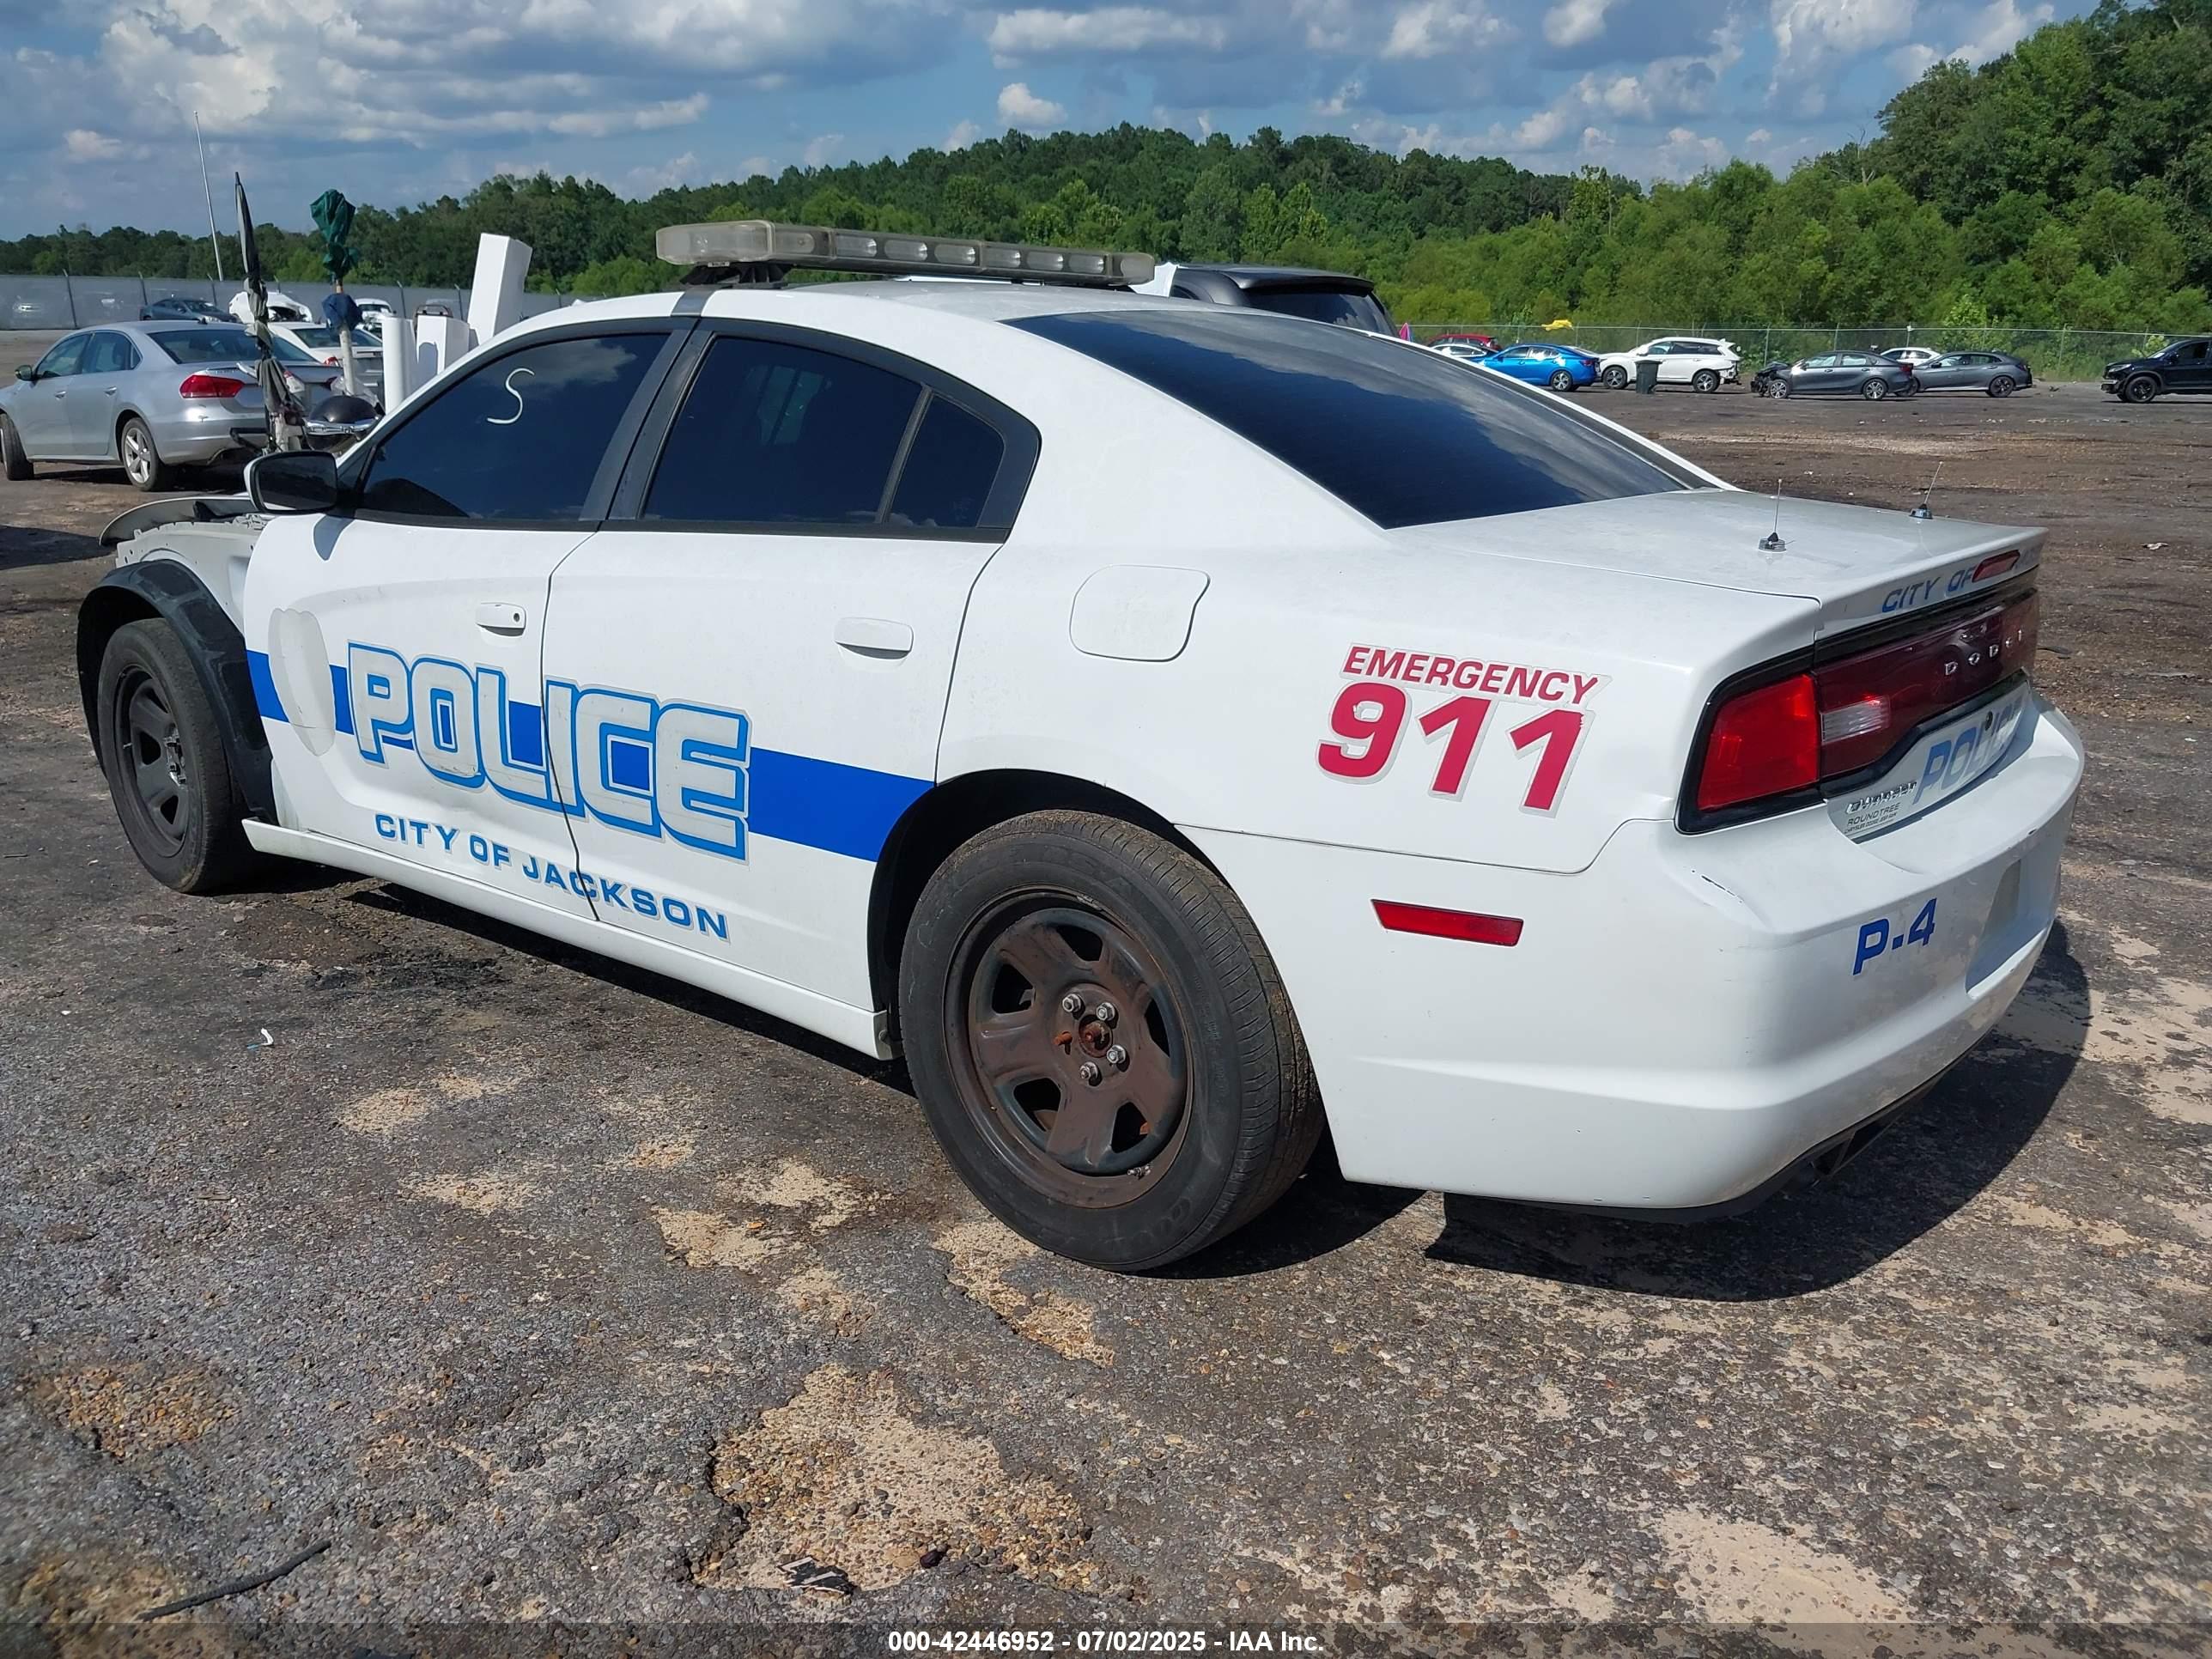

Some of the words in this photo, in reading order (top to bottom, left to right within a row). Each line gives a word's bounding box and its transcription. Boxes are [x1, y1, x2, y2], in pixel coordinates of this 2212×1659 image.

[1881, 576, 1942, 613] CITY
[1342, 645, 1599, 705] EMERGENCY
[347, 640, 752, 864] POLICE
[1317, 681, 1586, 811] 911
[1846, 802, 1901, 826] ROUNDTREE
[374, 813, 459, 853] CITY
[469, 833, 513, 867] OF
[522, 855, 731, 941] JACKSON
[1852, 897, 1938, 977] P-4
